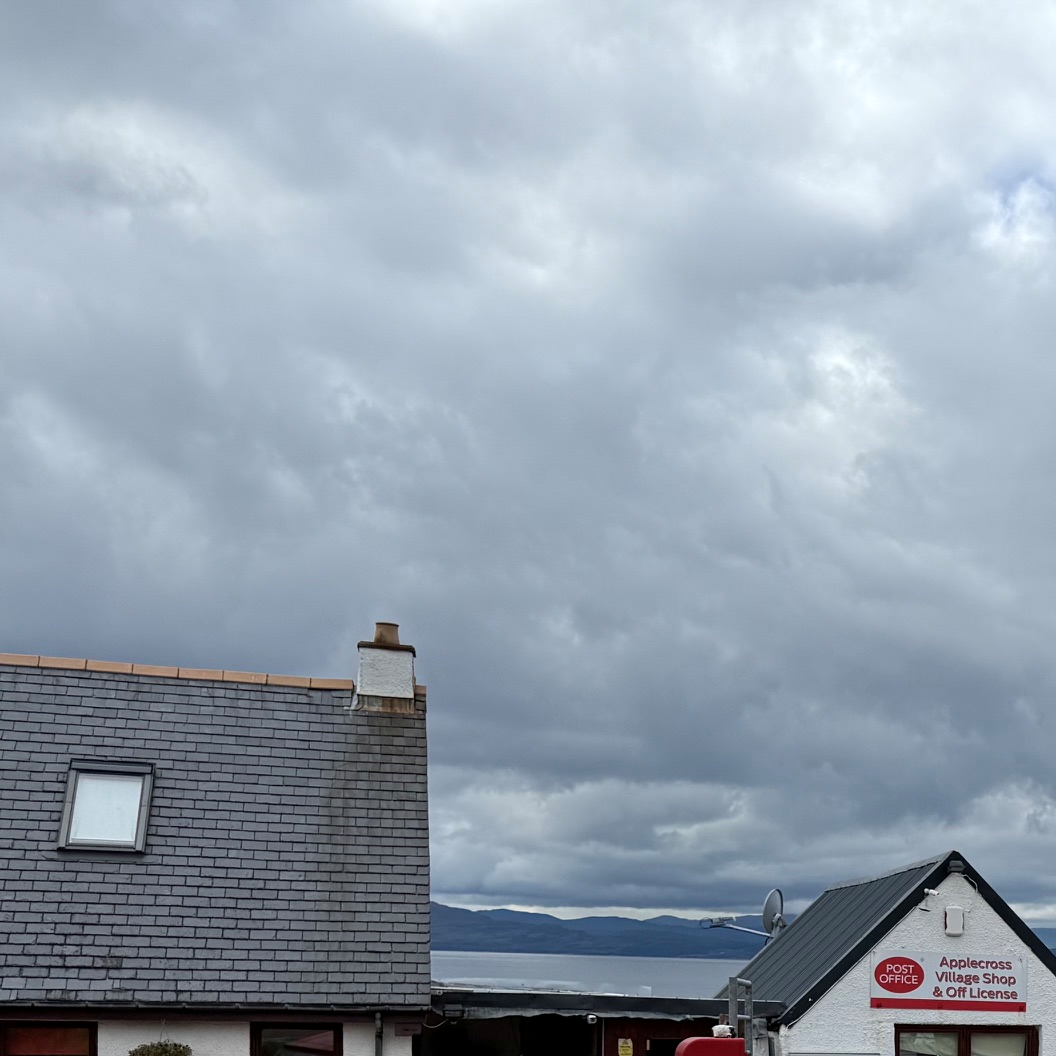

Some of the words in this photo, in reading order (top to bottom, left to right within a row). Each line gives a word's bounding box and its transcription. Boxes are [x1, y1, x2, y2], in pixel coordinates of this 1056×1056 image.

[886, 963, 915, 974] POST
[939, 956, 1013, 970] Applecross
[879, 974, 919, 985] OFFICE
[935, 971, 980, 986] Village
[982, 973, 1017, 987] Shop
[932, 986, 943, 998] &
[946, 986, 967, 999] Off
[969, 987, 1018, 1000] License
